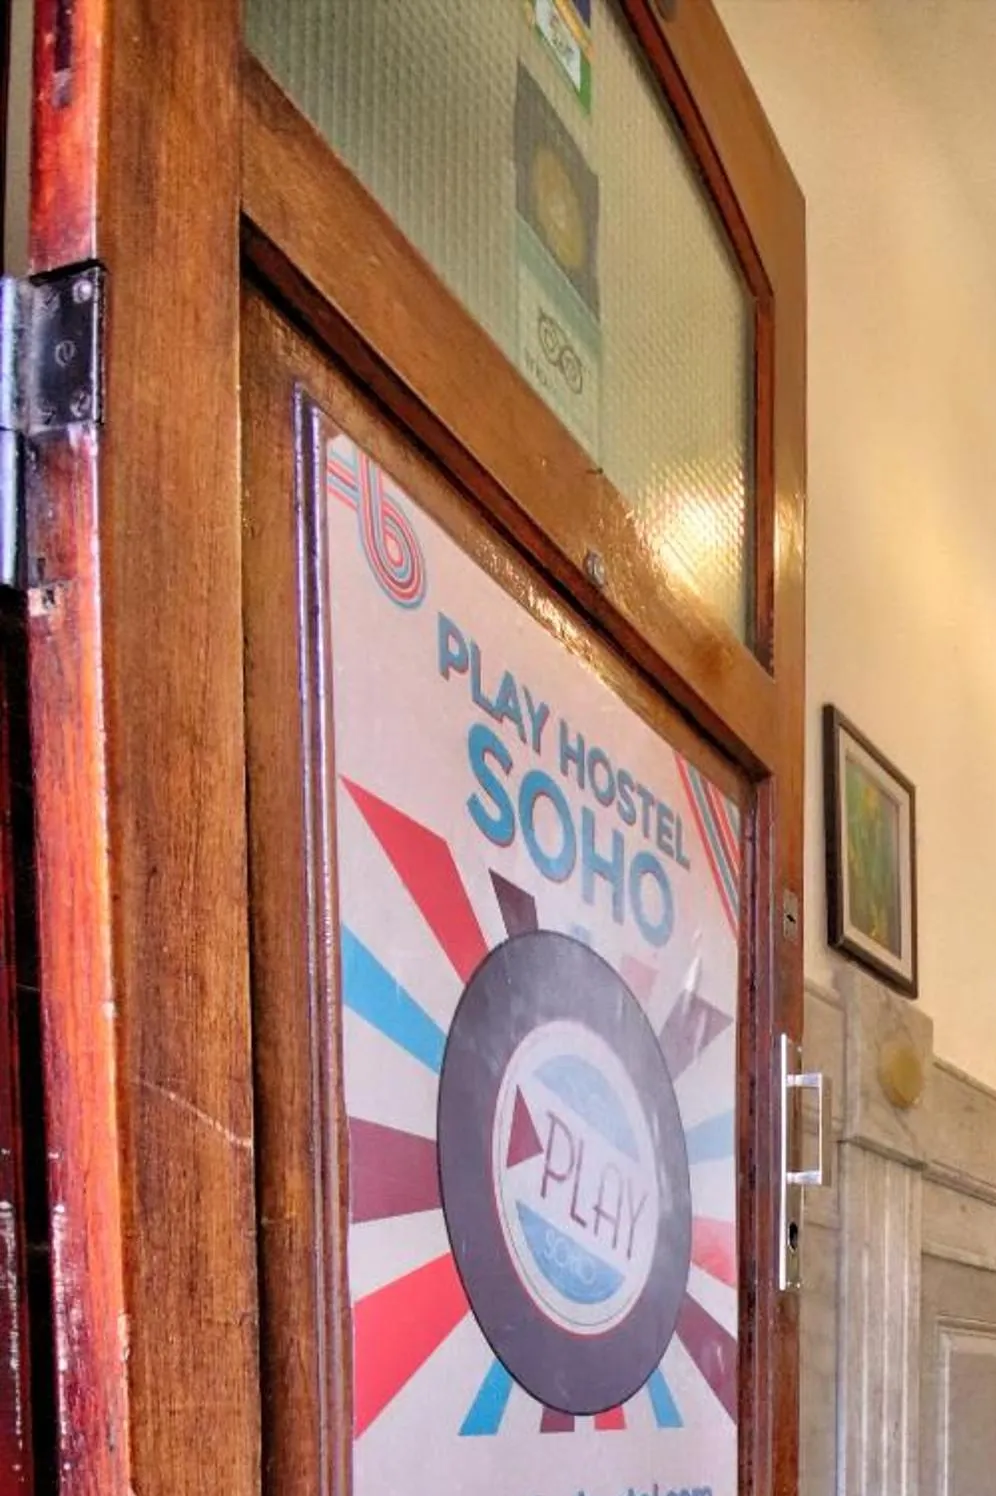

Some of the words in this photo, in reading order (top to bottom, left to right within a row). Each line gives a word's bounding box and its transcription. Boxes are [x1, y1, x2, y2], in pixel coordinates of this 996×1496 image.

[437, 610, 549, 754] PLAY
[559, 719, 691, 870] HOSTEL
[466, 722, 674, 949] SOHO
[540, 1110, 649, 1260] PLAY
